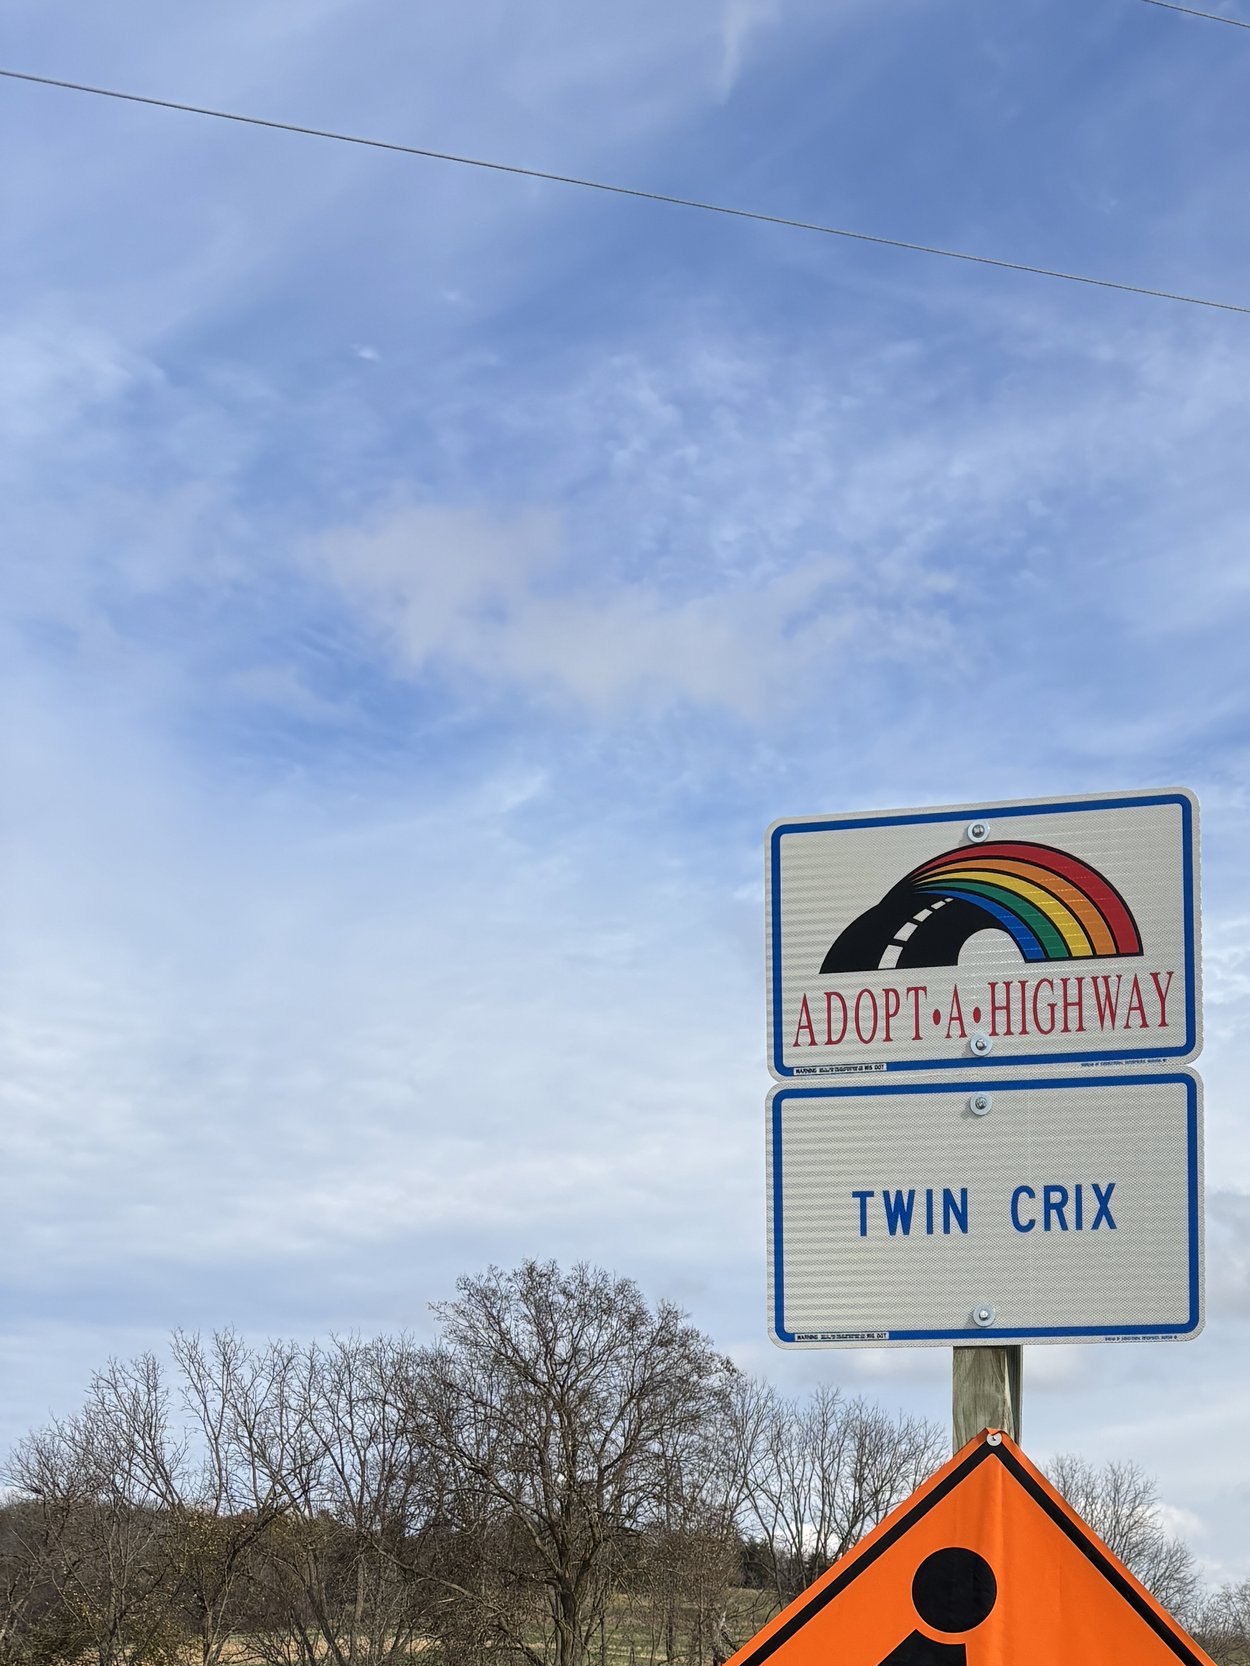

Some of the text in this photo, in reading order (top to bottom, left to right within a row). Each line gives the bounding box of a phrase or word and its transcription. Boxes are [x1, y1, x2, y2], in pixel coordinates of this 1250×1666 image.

[793, 986, 928, 1047] ADOPT
[988, 971, 1175, 1038] HIGHWAY
[852, 1183, 1118, 1238] TWIN CRIX
